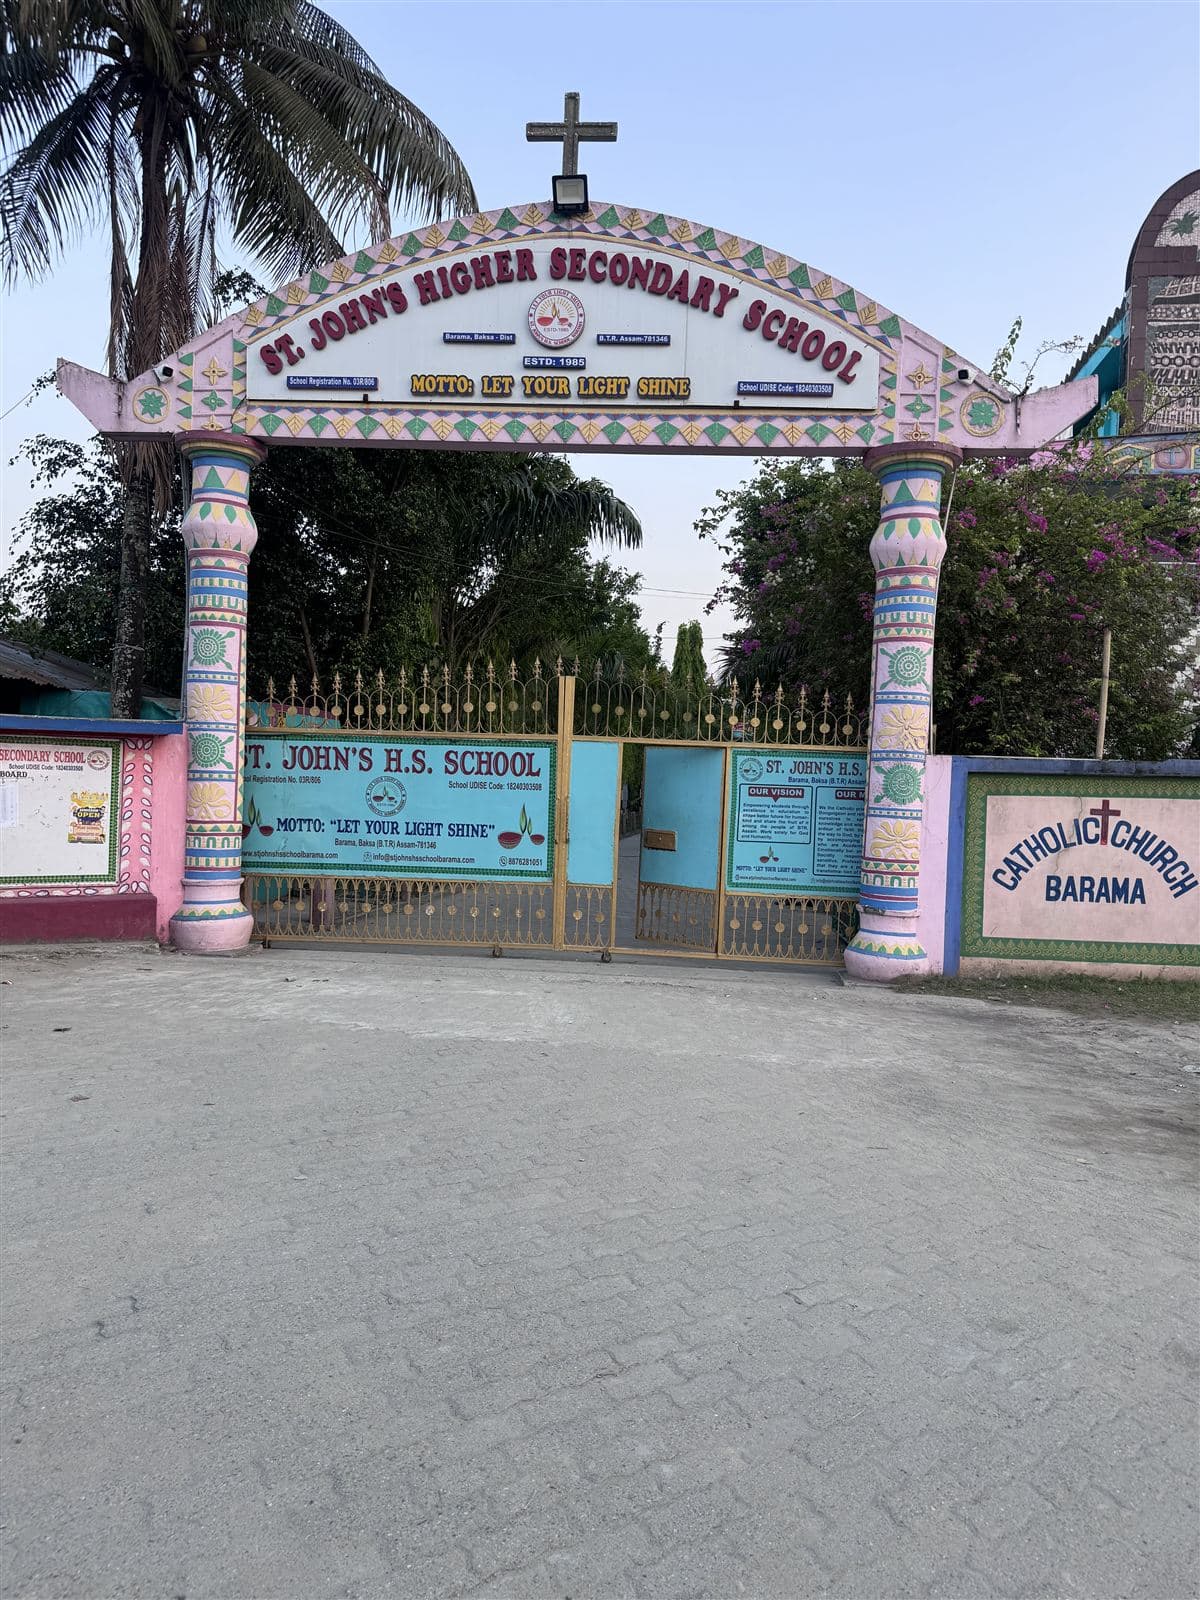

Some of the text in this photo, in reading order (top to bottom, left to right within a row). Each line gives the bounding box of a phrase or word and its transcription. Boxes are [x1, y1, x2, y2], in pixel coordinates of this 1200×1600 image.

[259, 247, 863, 384] ST. JOHN'S HIGHER SECONDARY SCHOOL
[445, 333, 473, 341] Barama,
[524, 357, 585, 366] ESTD: 1985
[289, 377, 307, 385] School
[308, 377, 341, 386] Registration
[411, 375, 690, 398] MOTTO: LET YOUR LIGHT SHINE
[740, 383, 758, 391] School
[759, 383, 777, 392] UDISE
[777, 383, 794, 392] Code:
[54, 751, 86, 763] SCHOOL
[383, 748, 433, 774] H.S.
[444, 750, 541, 777] SCHOOL
[766, 760, 784, 774] ST.
[790, 761, 833, 775] JOHN'S
[838, 762, 862, 776] H.S.
[0, 770, 28, 778] BOARD
[252, 775, 287, 784] Registration
[448, 780, 468, 789] School
[469, 781, 487, 789] UDISE
[488, 782, 505, 790] Code:
[749, 787, 803, 796] OUR VISION
[276, 818, 325, 833] MOTTO:
[365, 820, 400, 835] YOUR
[405, 821, 443, 836] LIGHT
[359, 839, 375, 847] Baksa
[992, 817, 1199, 899] CATHOLIC CHURCH
[1045, 875, 1147, 905] BARAMA
